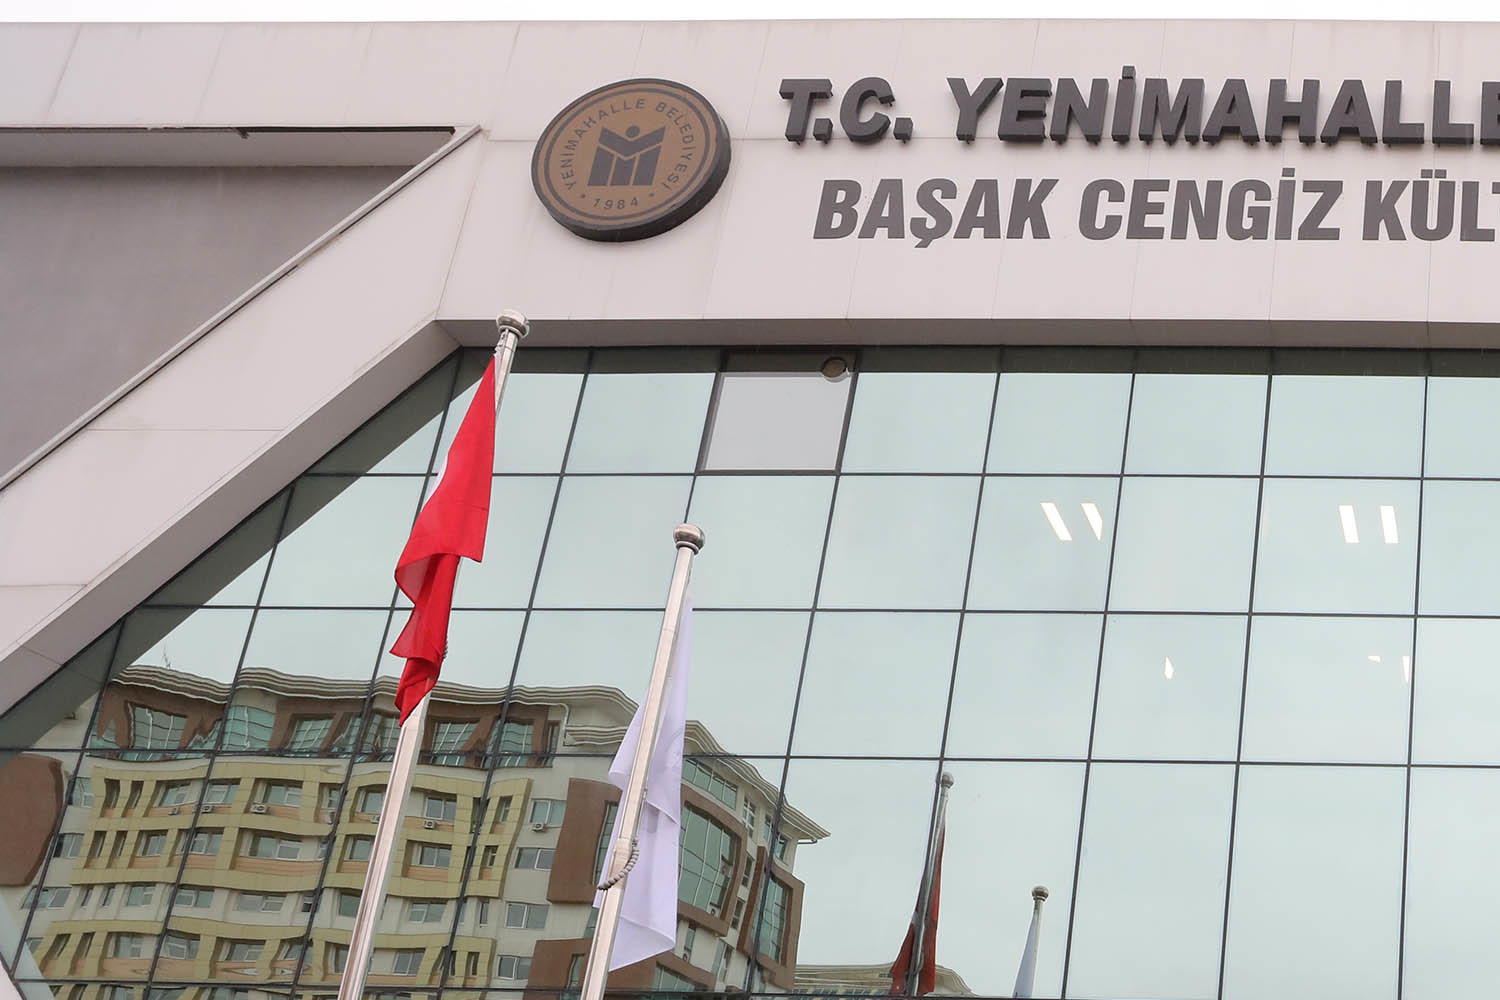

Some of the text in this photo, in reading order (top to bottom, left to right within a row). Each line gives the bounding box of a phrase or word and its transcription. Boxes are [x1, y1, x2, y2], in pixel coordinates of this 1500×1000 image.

[779, 76, 914, 144] T.C.
[592, 196, 639, 211] 1984
[812, 178, 1060, 249] BAŞAK
[1077, 166, 1345, 241] CENGİZ
